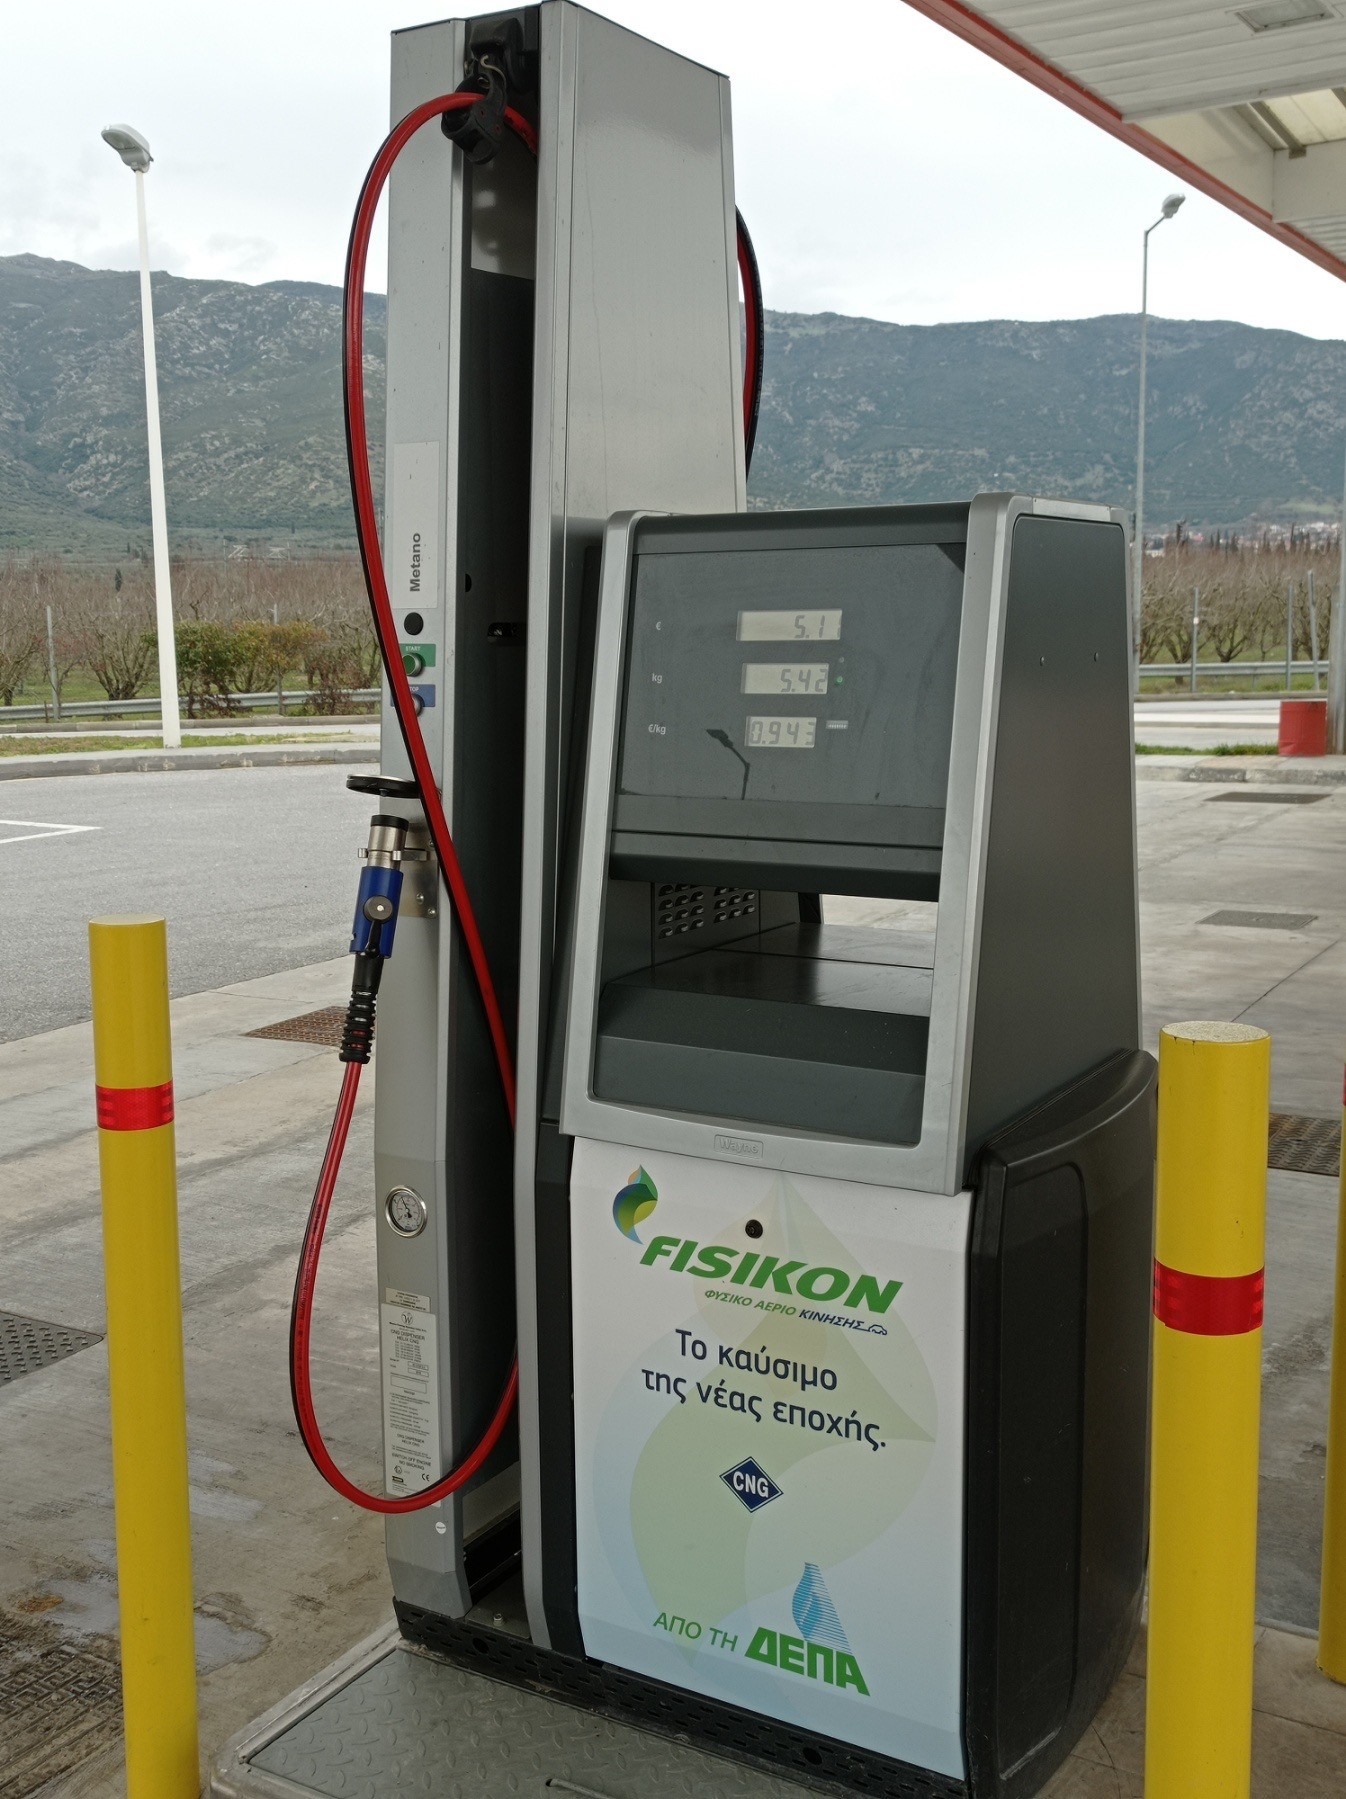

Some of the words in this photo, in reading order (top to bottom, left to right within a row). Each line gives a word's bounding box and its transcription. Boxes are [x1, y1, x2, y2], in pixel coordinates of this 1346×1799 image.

[409, 532, 421, 592] Metano
[655, 621, 662, 631] €
[652, 673, 663, 684] kg
[780, 668, 828, 693] 5.42
[648, 724, 666, 736] €/kg
[749, 720, 816, 745] 0.943
[639, 1236, 904, 1314] FISIKON
[704, 1289, 753, 1307] ΦΥΣΙΚΟ
[754, 1297, 797, 1316] ΑΕΡΙΟ
[798, 1309, 865, 1331] ΚΙΝΗΣΗΣ
[675, 1329, 707, 1360] Το
[718, 1345, 838, 1392] καύσιμο
[641, 1369, 687, 1403] της
[696, 1379, 762, 1422] νέας
[773, 1401, 887, 1451] εποχής.
[732, 1471, 769, 1498] CNG
[652, 1612, 702, 1640] ΑΠΟ
[709, 1627, 739, 1652] ΤΗ
[744, 1626, 870, 1696] ΔΕΠΑ
